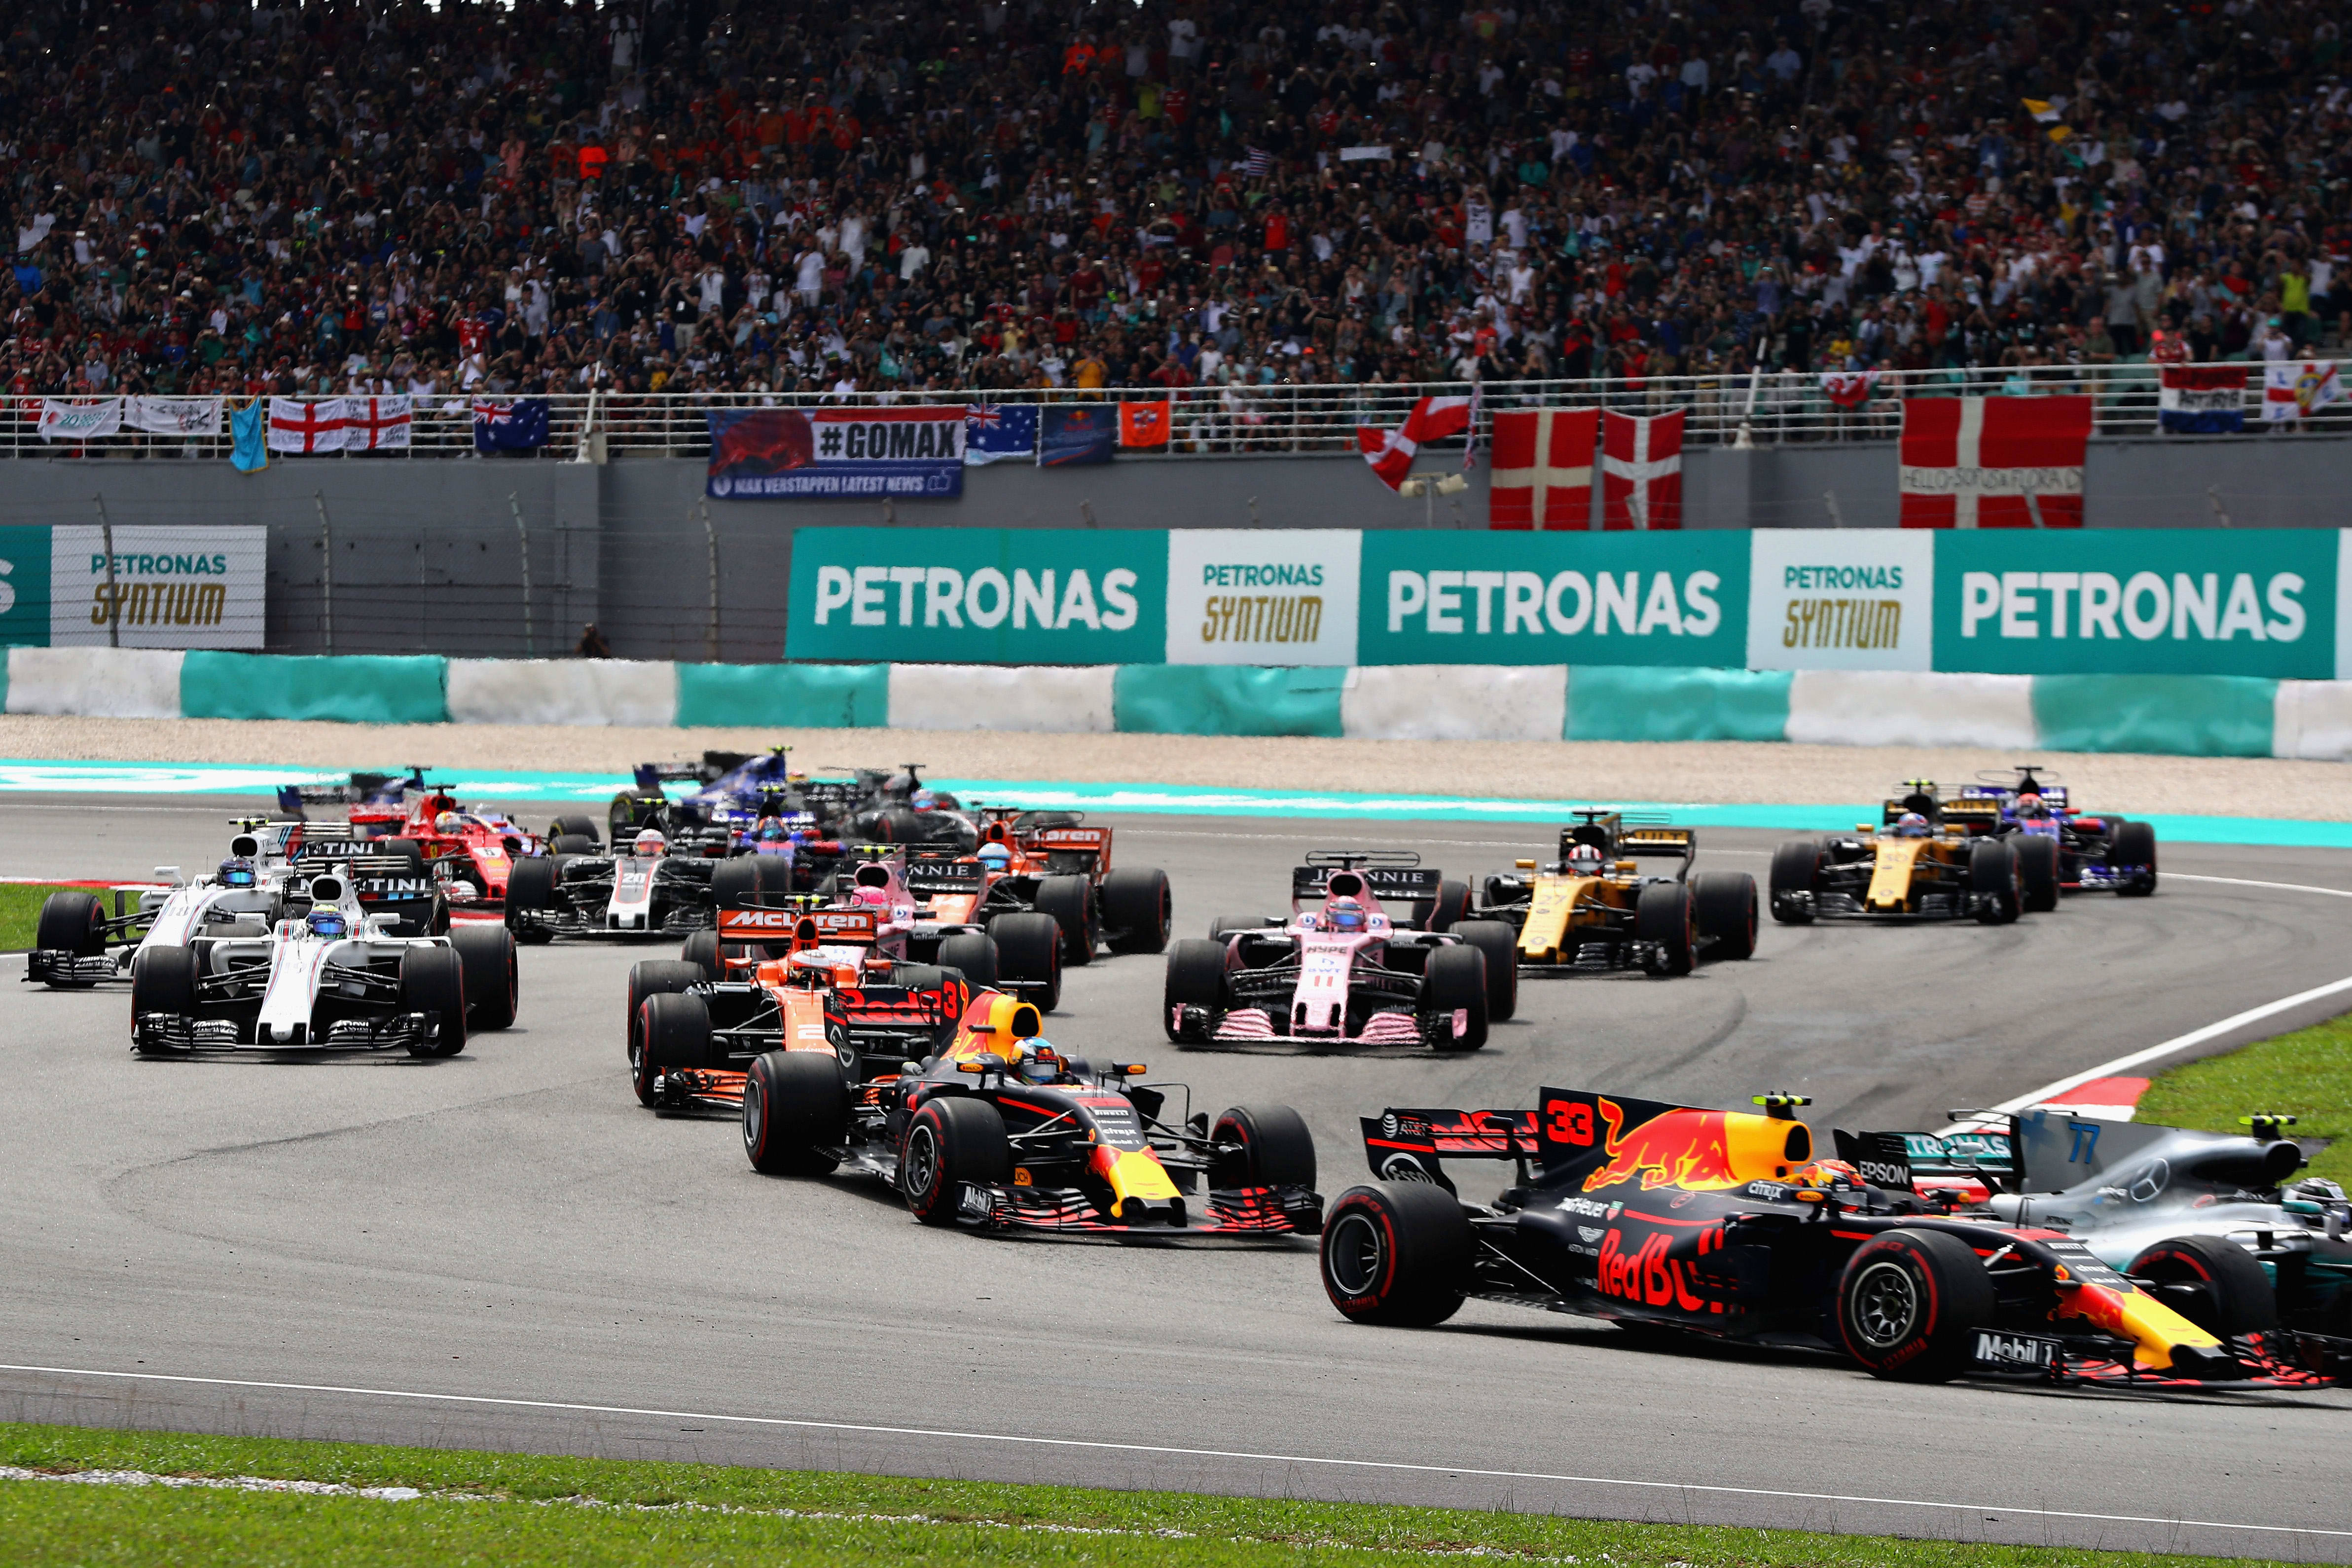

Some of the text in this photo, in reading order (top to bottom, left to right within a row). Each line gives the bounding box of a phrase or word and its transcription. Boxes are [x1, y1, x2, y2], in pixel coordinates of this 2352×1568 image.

[820, 422, 956, 459] #GOMAX
[734, 475, 924, 493] MAX VERSTAPPEN LATEST NEWS
[91, 553, 227, 575] PETRONAS
[1203, 563, 1324, 586] PETRONAS
[1784, 565, 1903, 589] PETRONAS
[91, 583, 226, 625] SYNTIUM
[815, 566, 1138, 630] PETRONAS
[1388, 570, 1721, 636] PETRONAS
[1961, 571, 2306, 642] PETRONAS
[1201, 595, 1323, 643] SYNTIUM
[1782, 599, 1902, 649] SYNTIUM
[323, 842, 374, 855] TINI
[622, 873, 646, 883] 20
[909, 864, 969, 876] NNIE
[1312, 869, 1424, 883] JNNIE
[727, 912, 868, 927] McLren
[1307, 946, 1348, 954] HYPE
[1547, 1099, 1594, 1146] 33
[2068, 1121, 2100, 1164] 77
[1859, 1160, 1908, 1184] EPSON
[1976, 1333, 2053, 1366] Mobil 1
